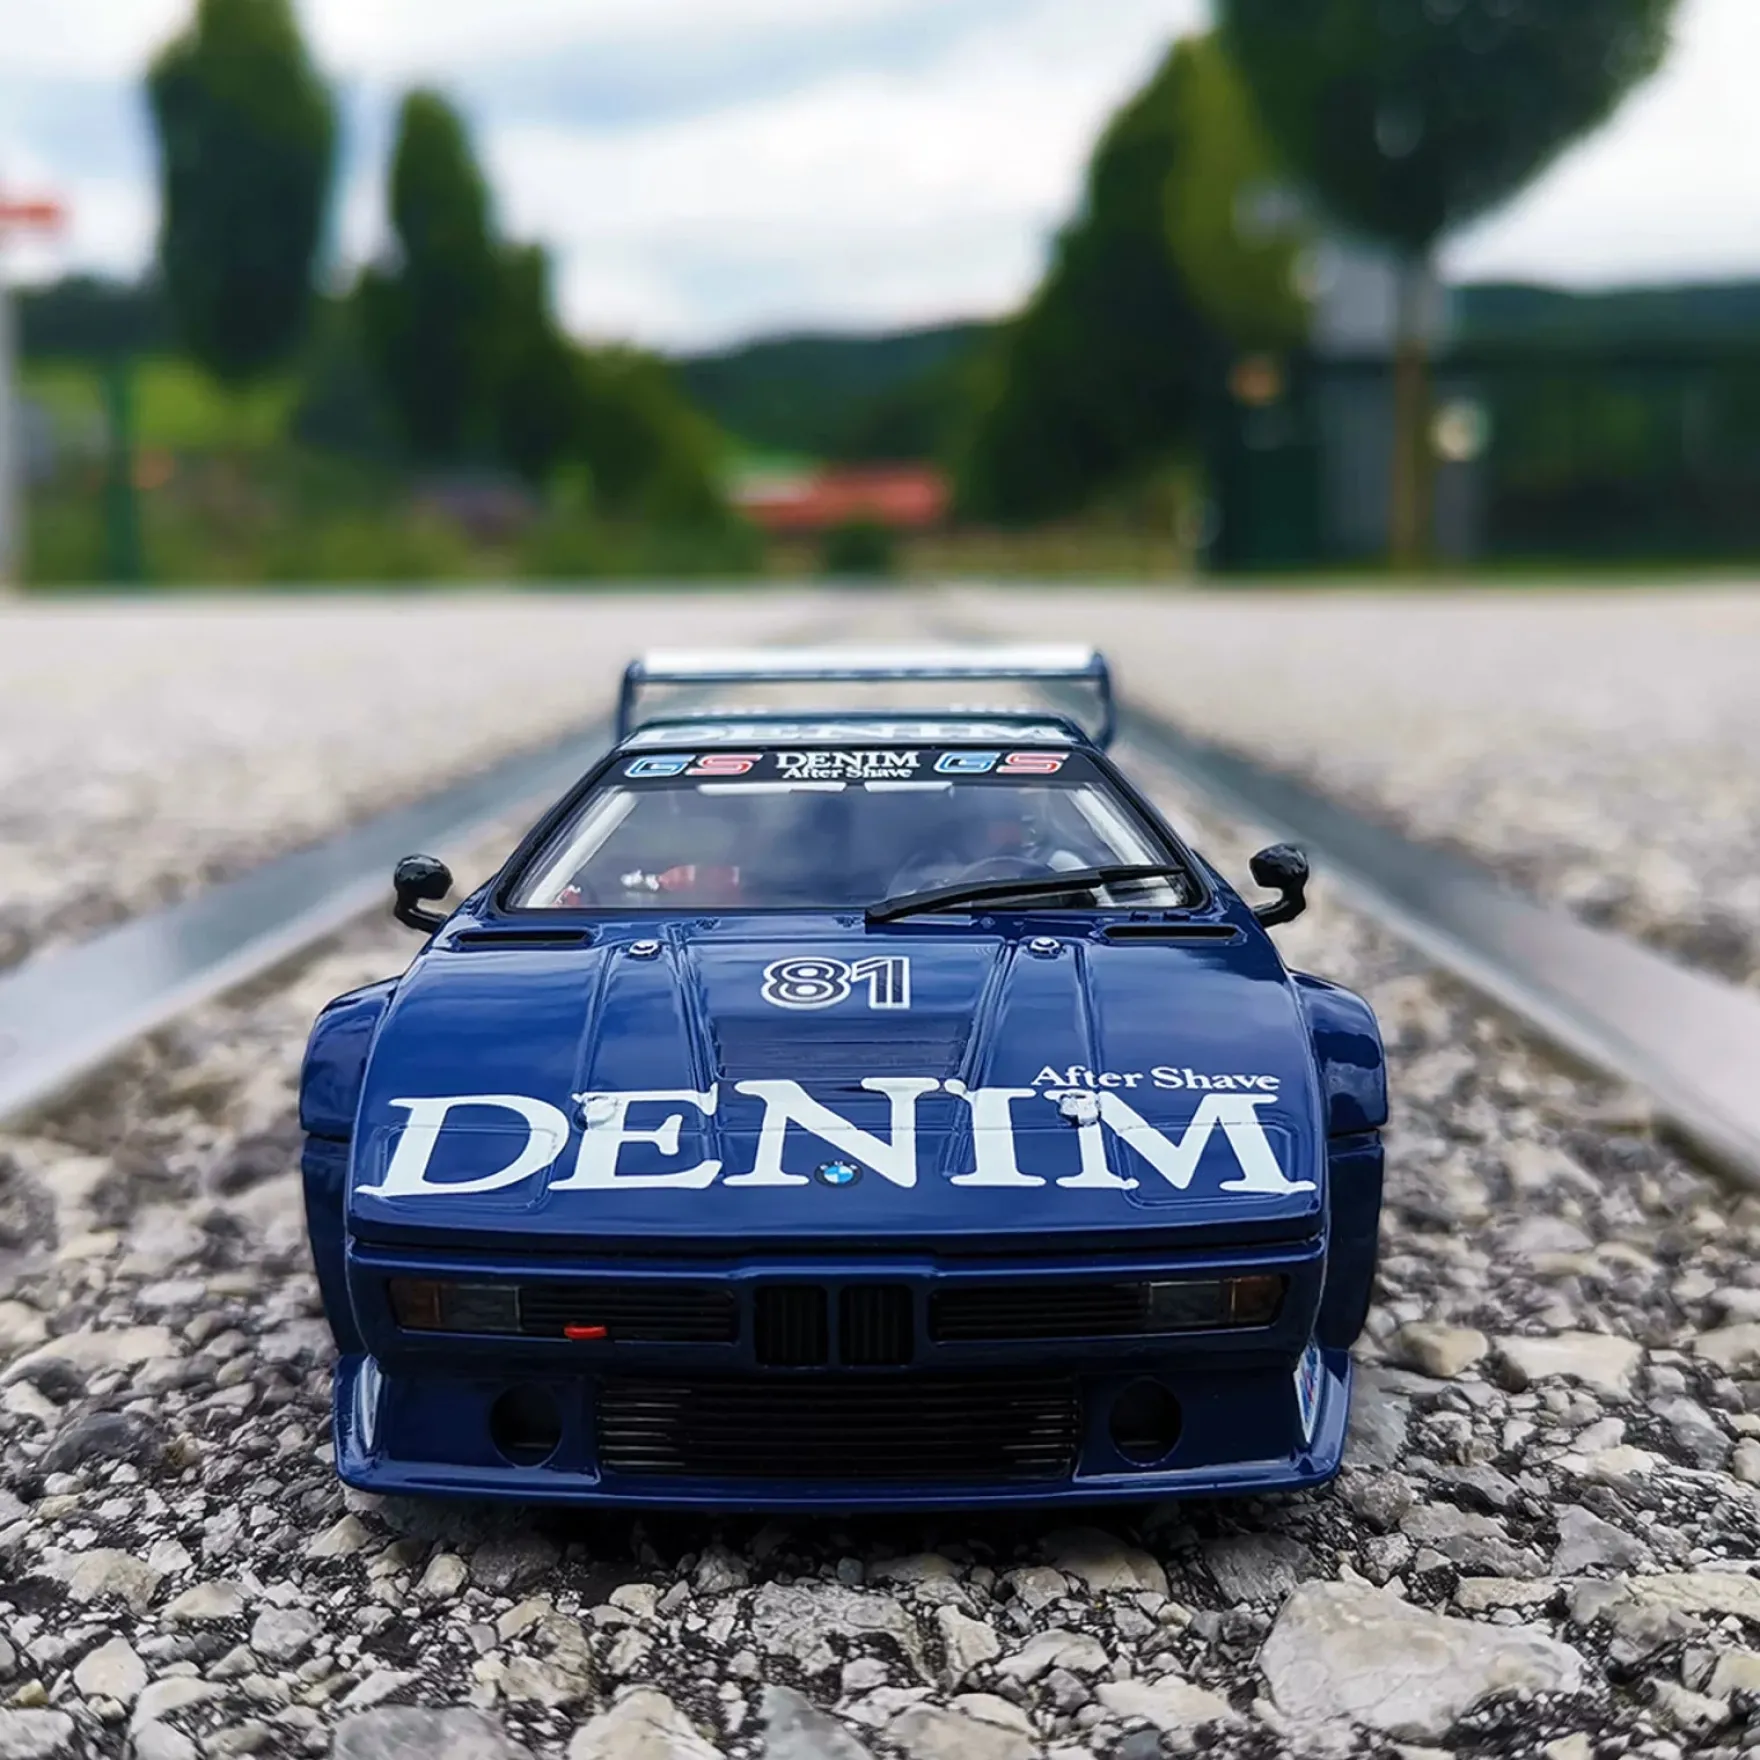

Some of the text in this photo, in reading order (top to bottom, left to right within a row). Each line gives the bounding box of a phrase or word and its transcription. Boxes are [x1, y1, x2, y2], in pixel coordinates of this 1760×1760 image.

[624, 754, 763, 777] GS
[776, 751, 920, 769] DENIM
[782, 764, 913, 778] After Shave
[933, 752, 1070, 773] GS
[760, 956, 911, 1010] 81
[1031, 1065, 1280, 1090] After Shave
[354, 1076, 1316, 1197] DENIM
